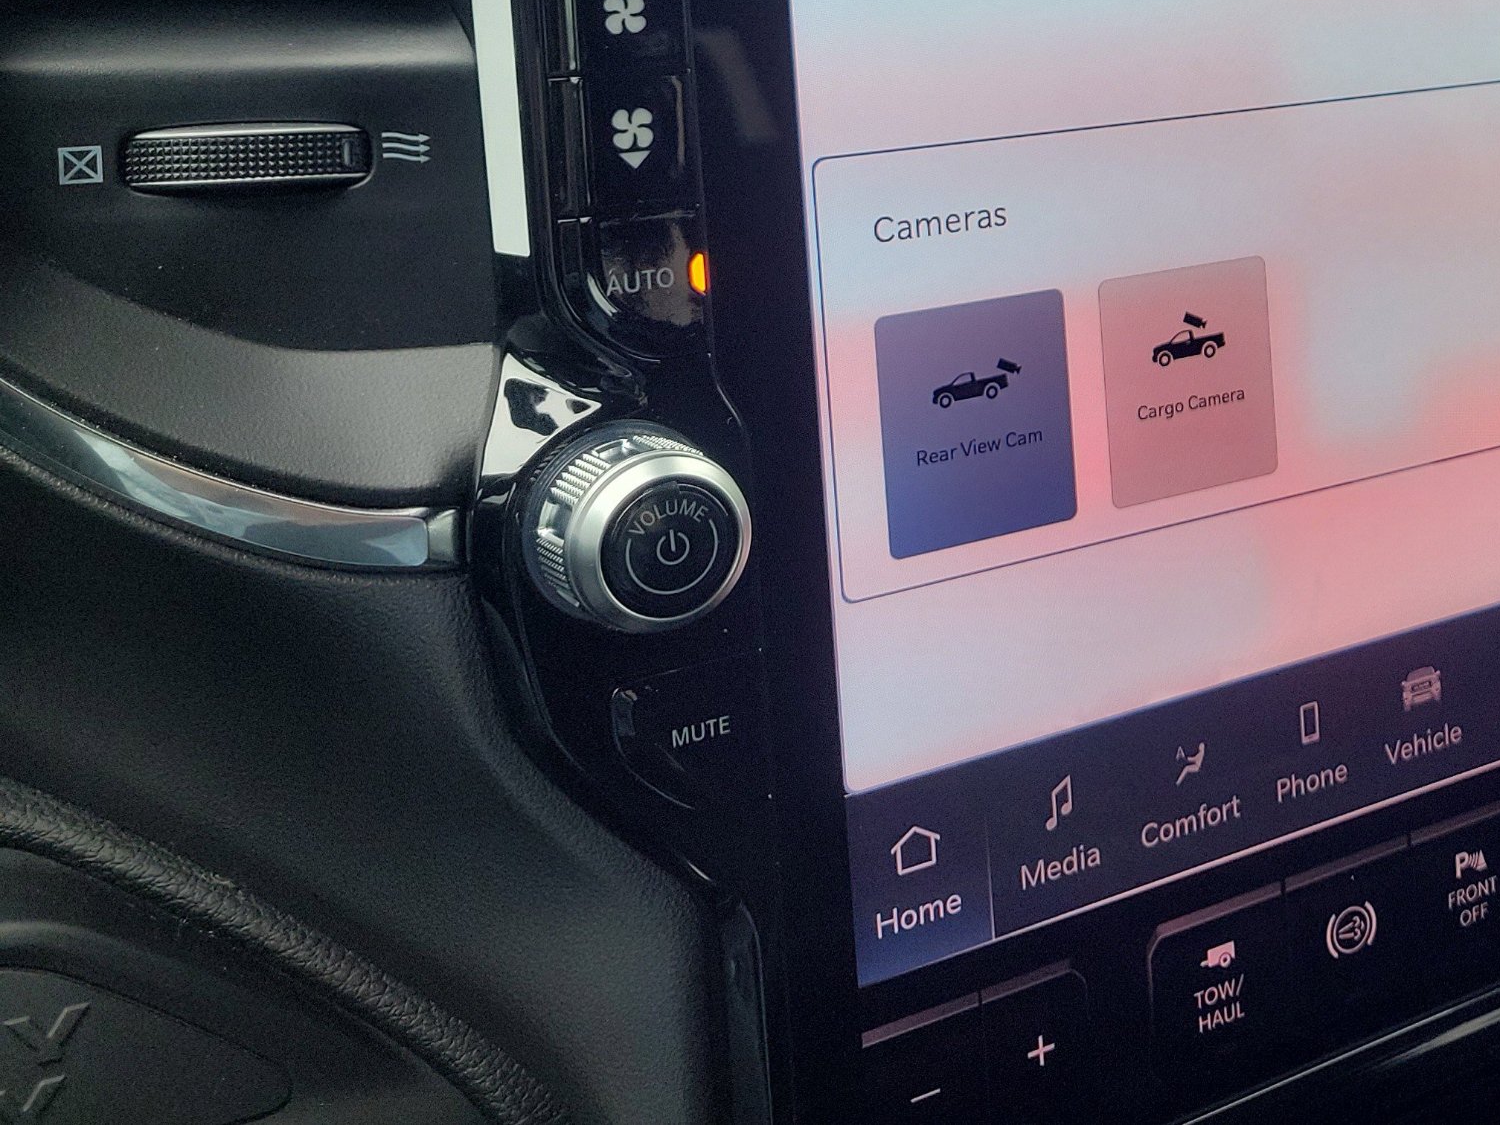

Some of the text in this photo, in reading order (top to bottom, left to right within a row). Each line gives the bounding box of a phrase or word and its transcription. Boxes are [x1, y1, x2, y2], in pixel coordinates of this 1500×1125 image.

[873, 206, 1008, 243] Cameras
[606, 266, 674, 297] AUTO
[1136, 388, 1246, 423] Cargo Camera
[916, 428, 1044, 467] Rear View Cam
[628, 497, 711, 538] VOLUME
[671, 715, 731, 748] MUTE
[1384, 722, 1463, 766] Vehicle
[1275, 763, 1348, 804] Phone
[1140, 794, 1242, 850] Comfort
[1019, 842, 1102, 892] Media
[1447, 874, 1498, 911] FRONT
[875, 892, 963, 941] Home
[1459, 901, 1490, 928] OFF
[1193, 973, 1244, 1010] TOW/
[1197, 1000, 1246, 1034] HAUL
